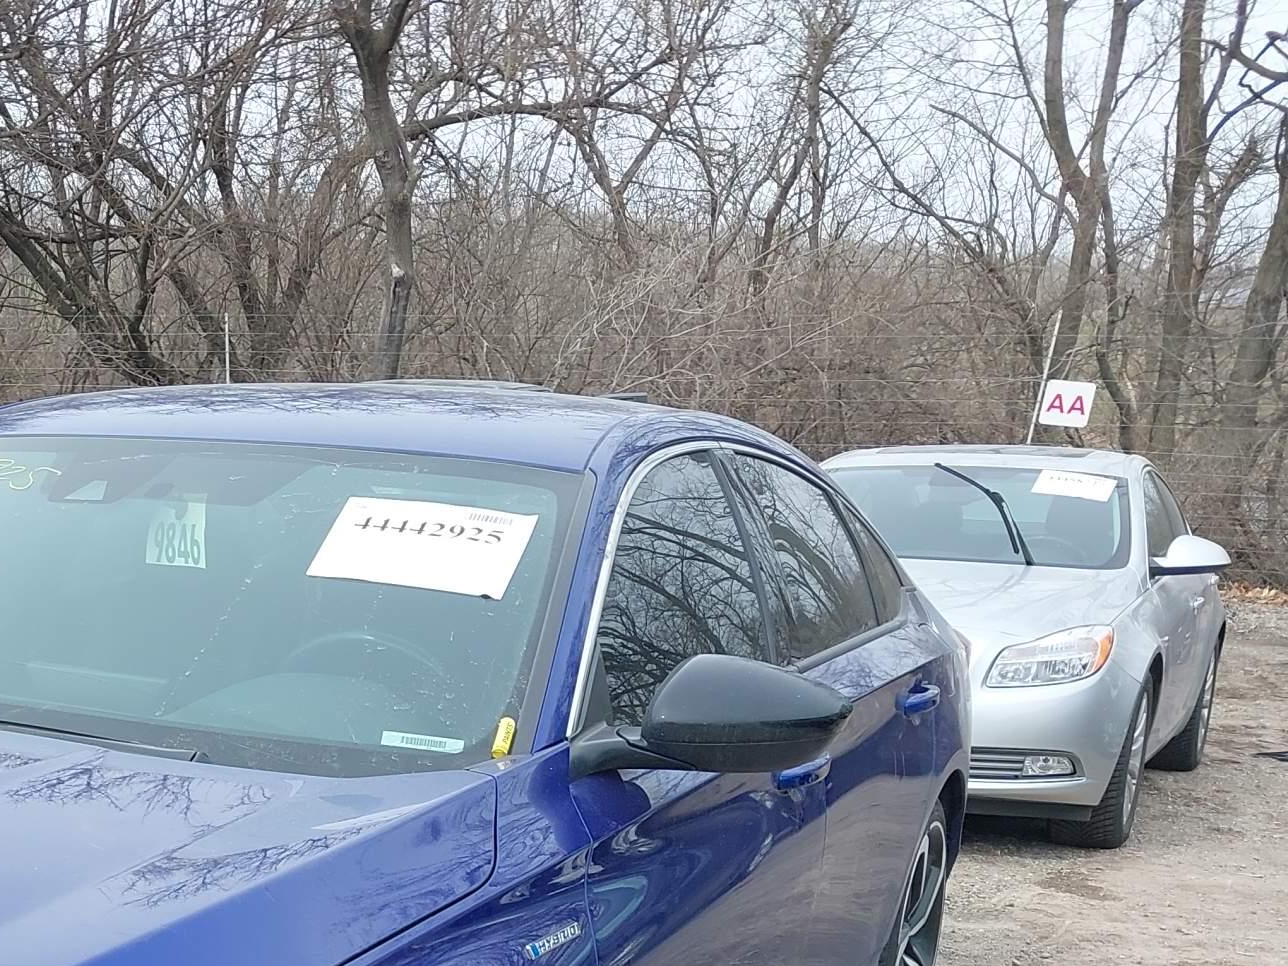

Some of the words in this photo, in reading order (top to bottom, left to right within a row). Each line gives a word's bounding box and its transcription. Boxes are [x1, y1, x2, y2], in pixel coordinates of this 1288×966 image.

[1046, 393, 1086, 416] AA
[154, 520, 201, 566] 9846
[353, 515, 506, 545] 44442925
